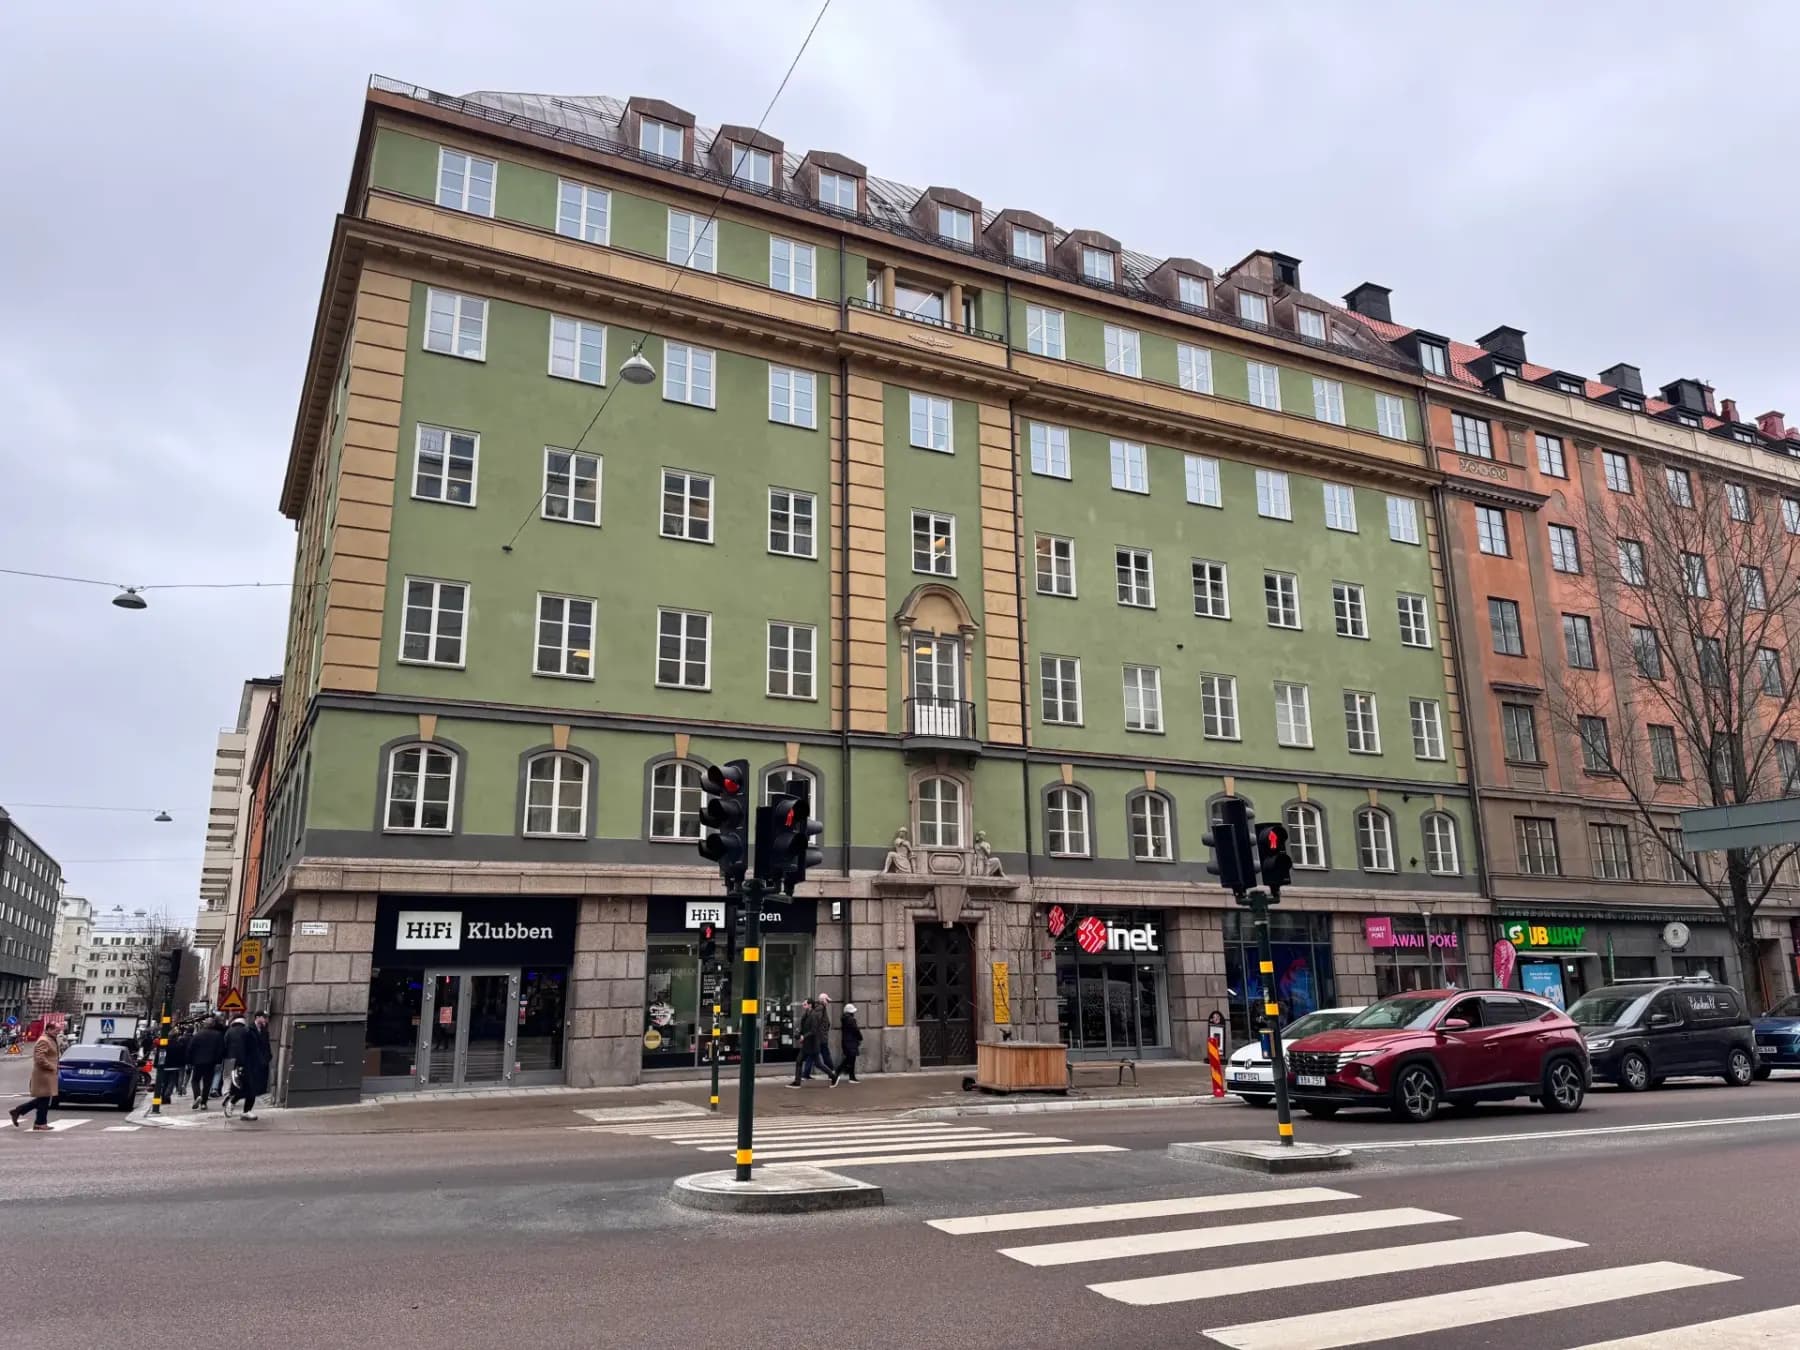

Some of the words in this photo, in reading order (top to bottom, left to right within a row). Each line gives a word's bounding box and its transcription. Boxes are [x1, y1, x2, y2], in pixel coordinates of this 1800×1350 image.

[691, 909, 721, 922] HiFi
[405, 921, 453, 939] HiFi
[467, 921, 553, 940] Klubben
[1107, 920, 1160, 952] inet
[1528, 925, 1585, 945] UBWAY
[1392, 934, 1425, 948] AWAII
